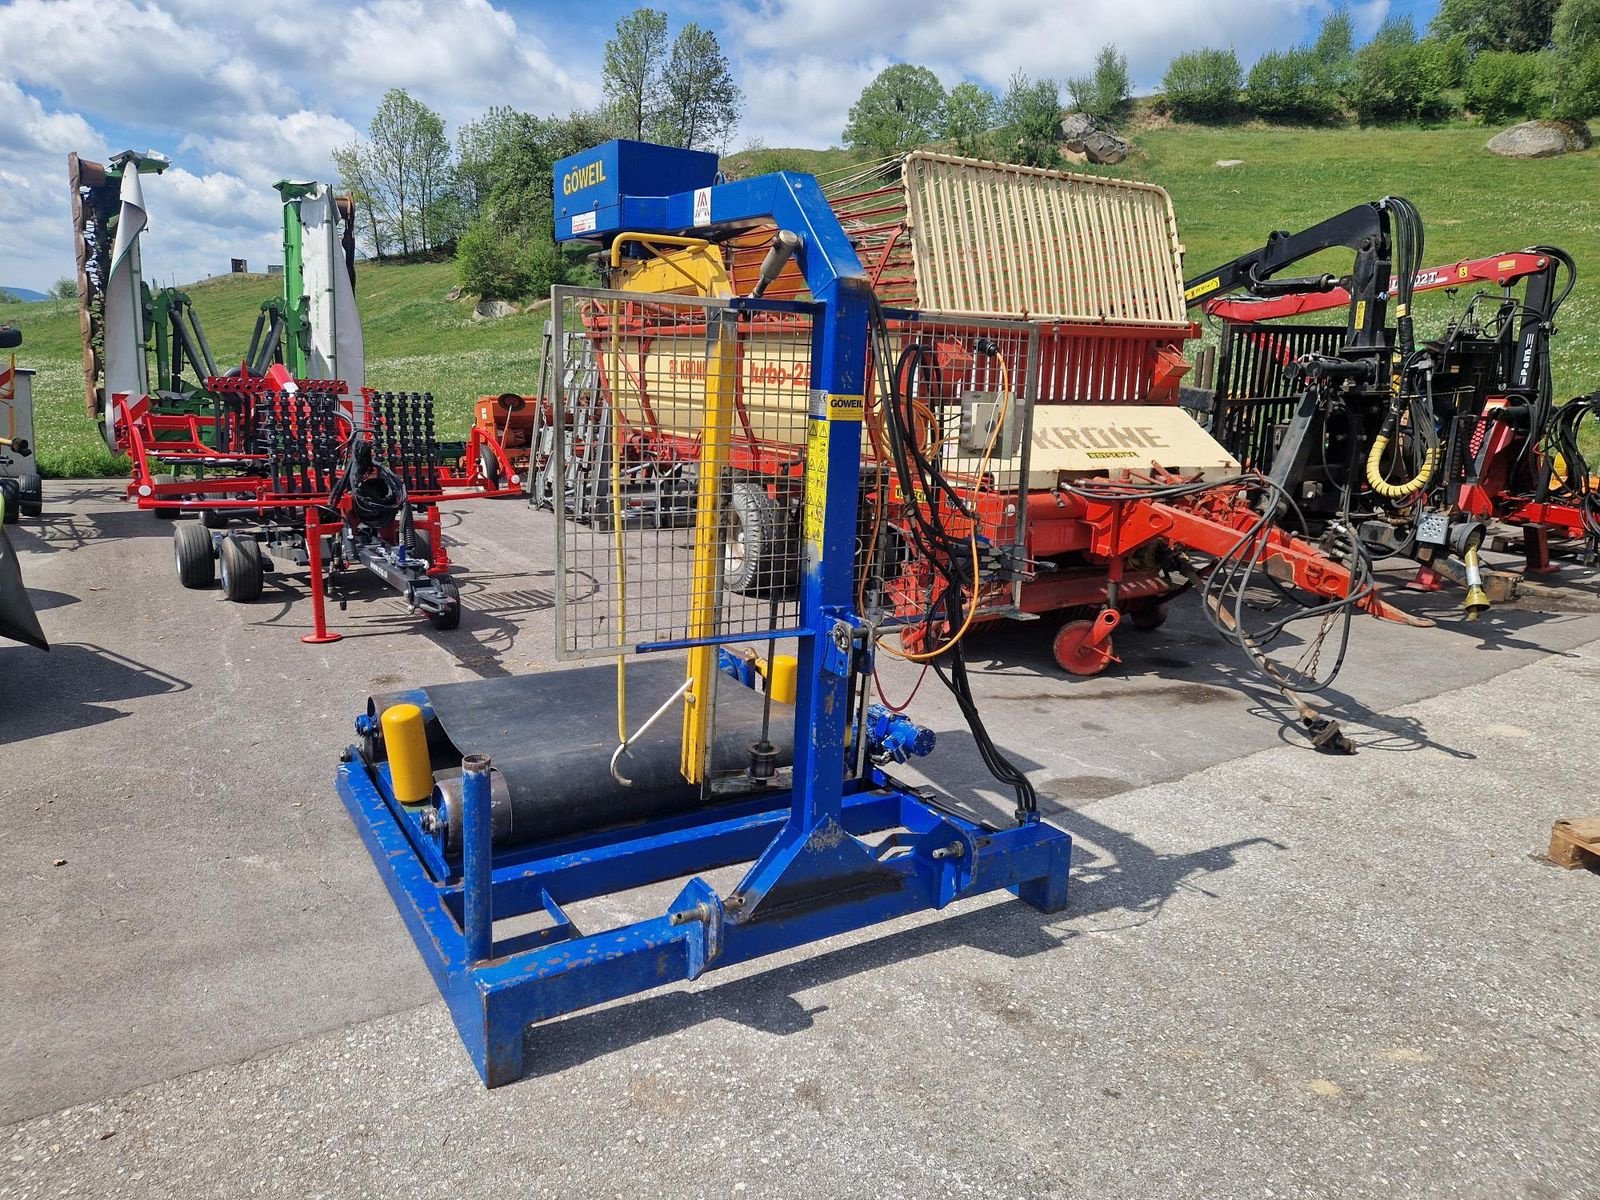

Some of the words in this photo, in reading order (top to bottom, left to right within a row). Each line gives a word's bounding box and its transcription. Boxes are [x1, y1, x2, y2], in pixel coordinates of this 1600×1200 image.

[563, 159, 606, 196] GÖWEIL
[680, 359, 706, 381] KRON
[1032, 426, 1170, 449] KRONE
